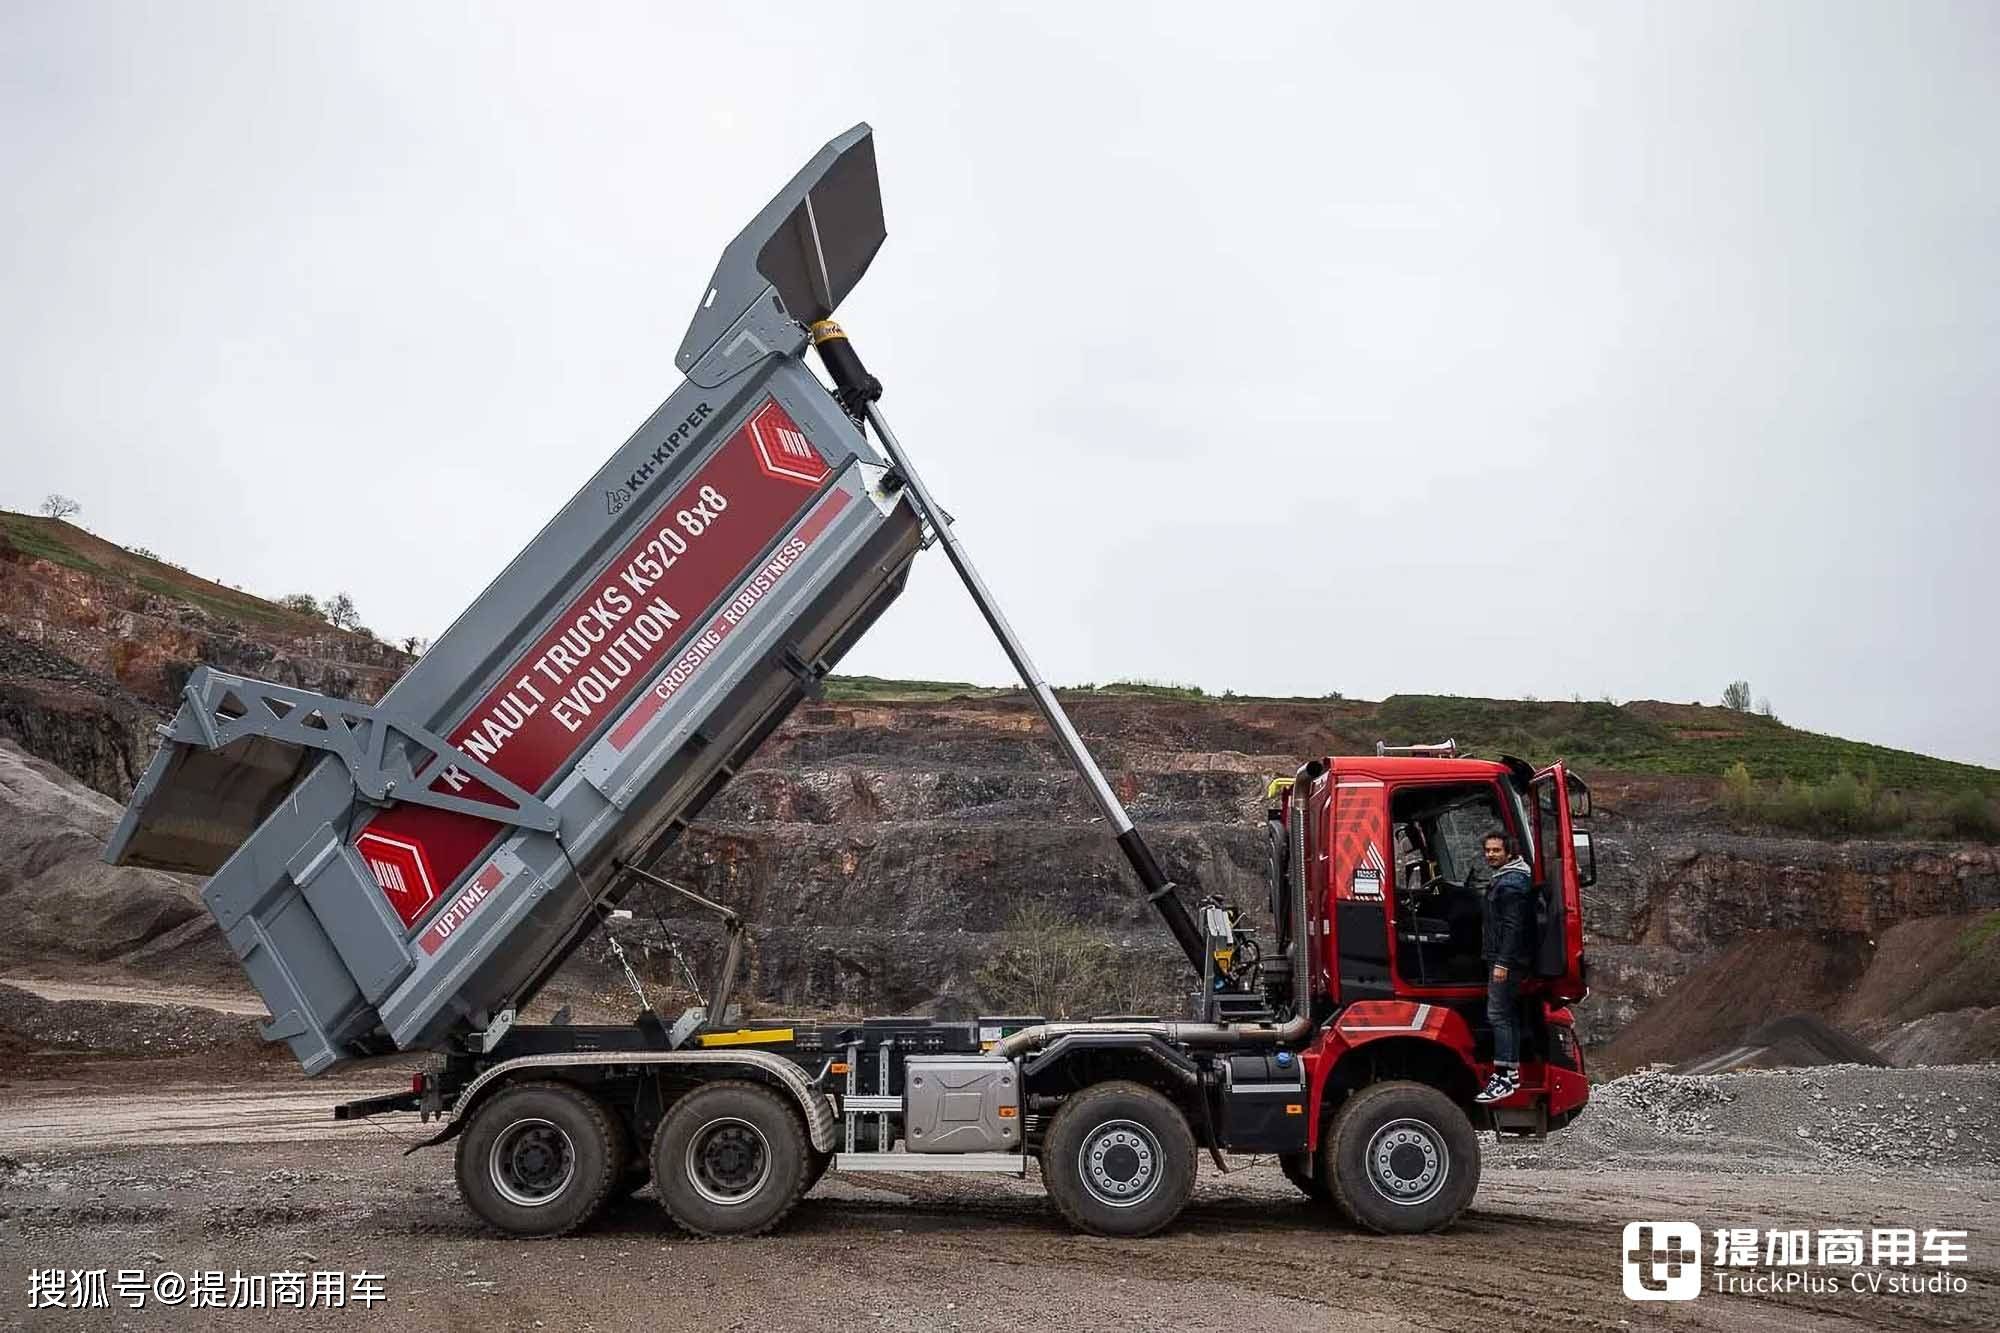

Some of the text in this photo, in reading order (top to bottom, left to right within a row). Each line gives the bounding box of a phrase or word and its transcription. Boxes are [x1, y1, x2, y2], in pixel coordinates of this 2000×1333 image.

[625, 402, 713, 491] KH-KIPPER
[442, 485, 728, 792] RNAULT TRUCKS K520 8x8
[550, 597, 680, 732] EVOLUTION
[655, 629, 721, 700] CROSSING
[723, 537, 806, 625] ROBUSTNESS
[435, 880, 489, 938] UPTIME
